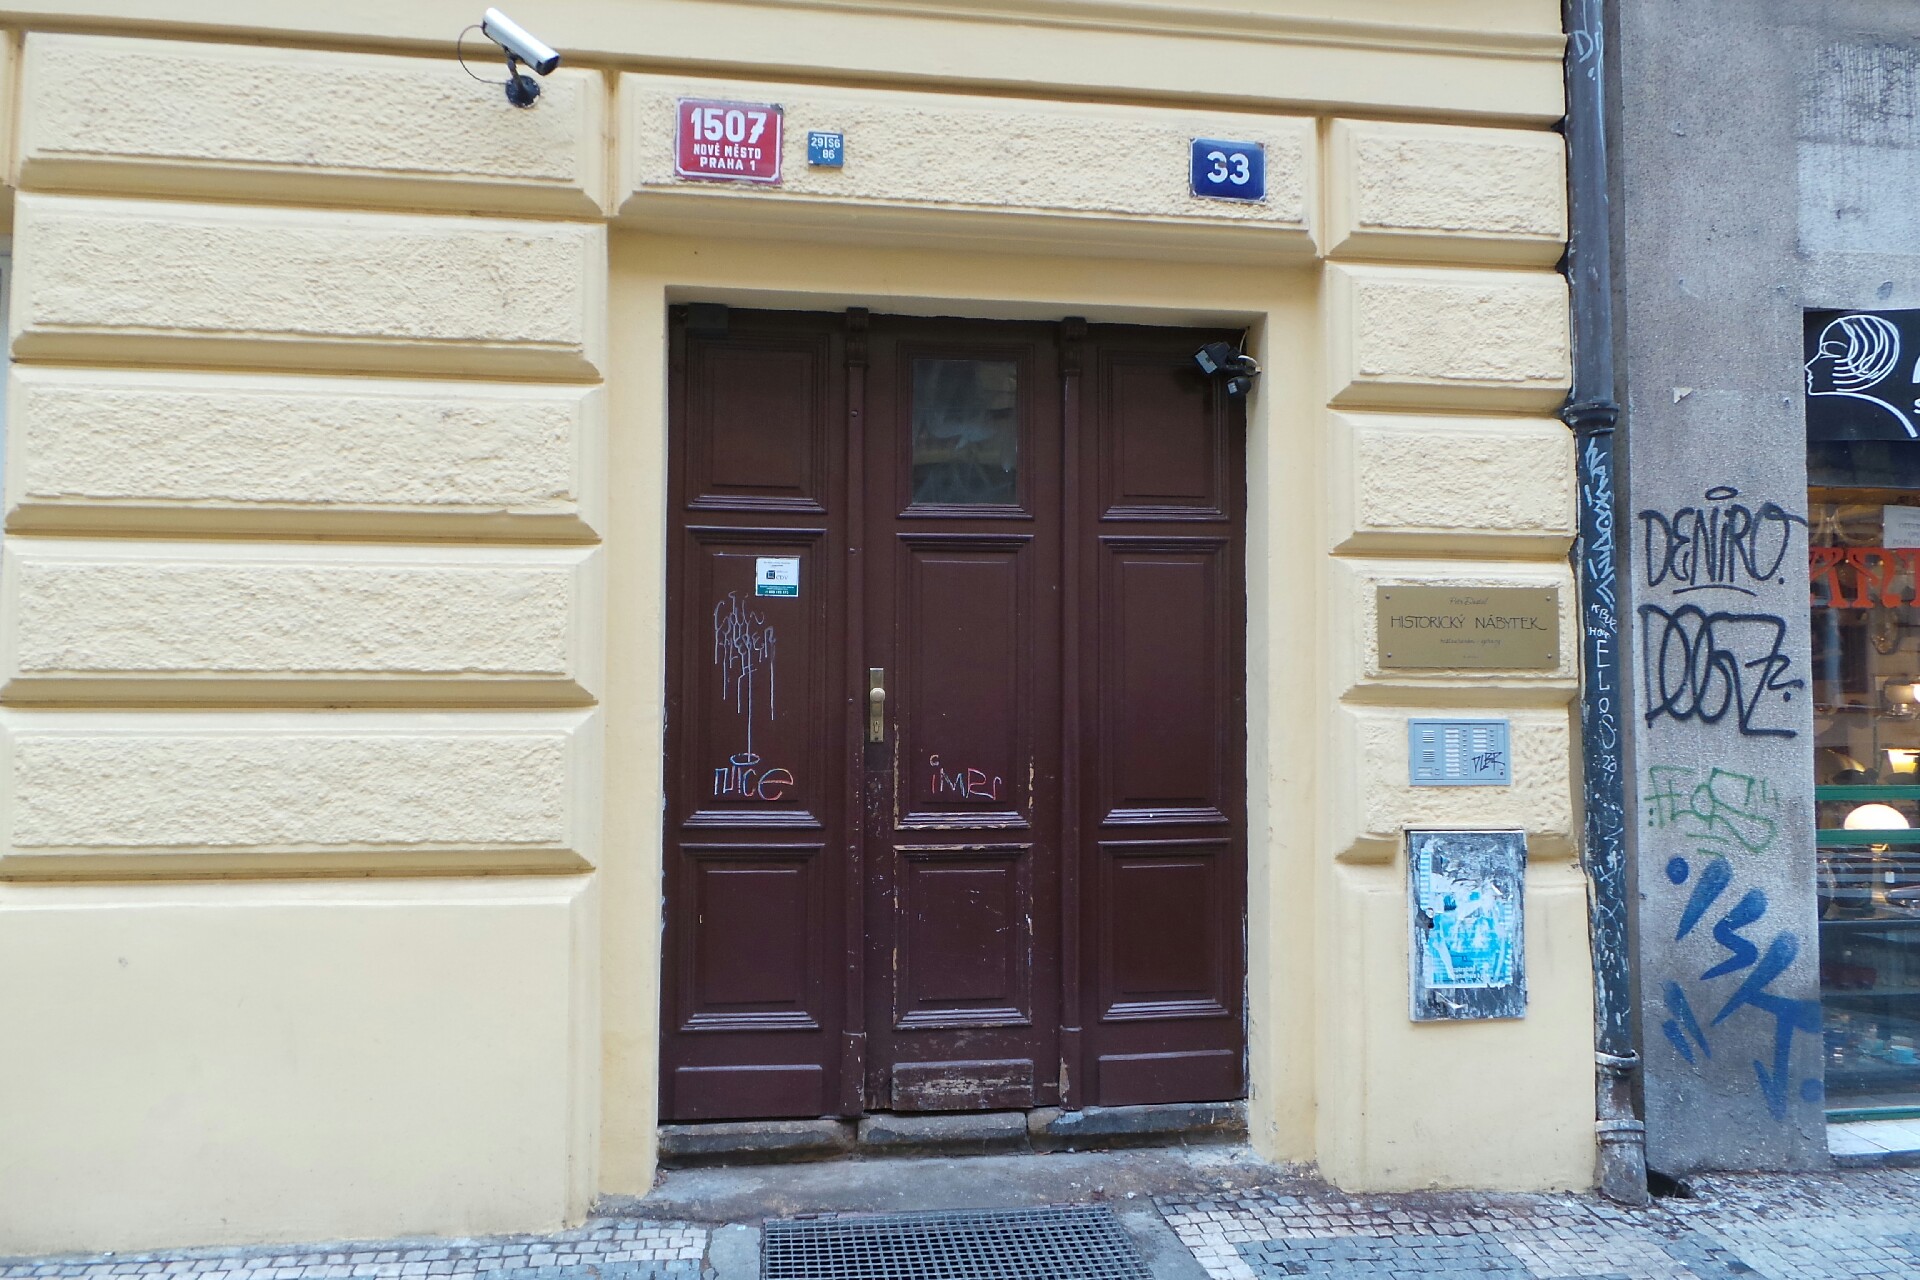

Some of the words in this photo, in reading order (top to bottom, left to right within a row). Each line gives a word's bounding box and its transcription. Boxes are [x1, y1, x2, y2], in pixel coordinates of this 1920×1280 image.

[691, 107, 767, 144] 1507
[694, 142, 720, 157] NOVÉ
[724, 143, 761, 160] MĚSTO
[822, 149, 835, 160] 86
[700, 156, 744, 171] PRAHA
[750, 160, 756, 171] 1
[1207, 151, 1250, 185] 33
[1391, 614, 1465, 629] HISTORICKÝ
[1475, 614, 1548, 631] NÁBYTEK
